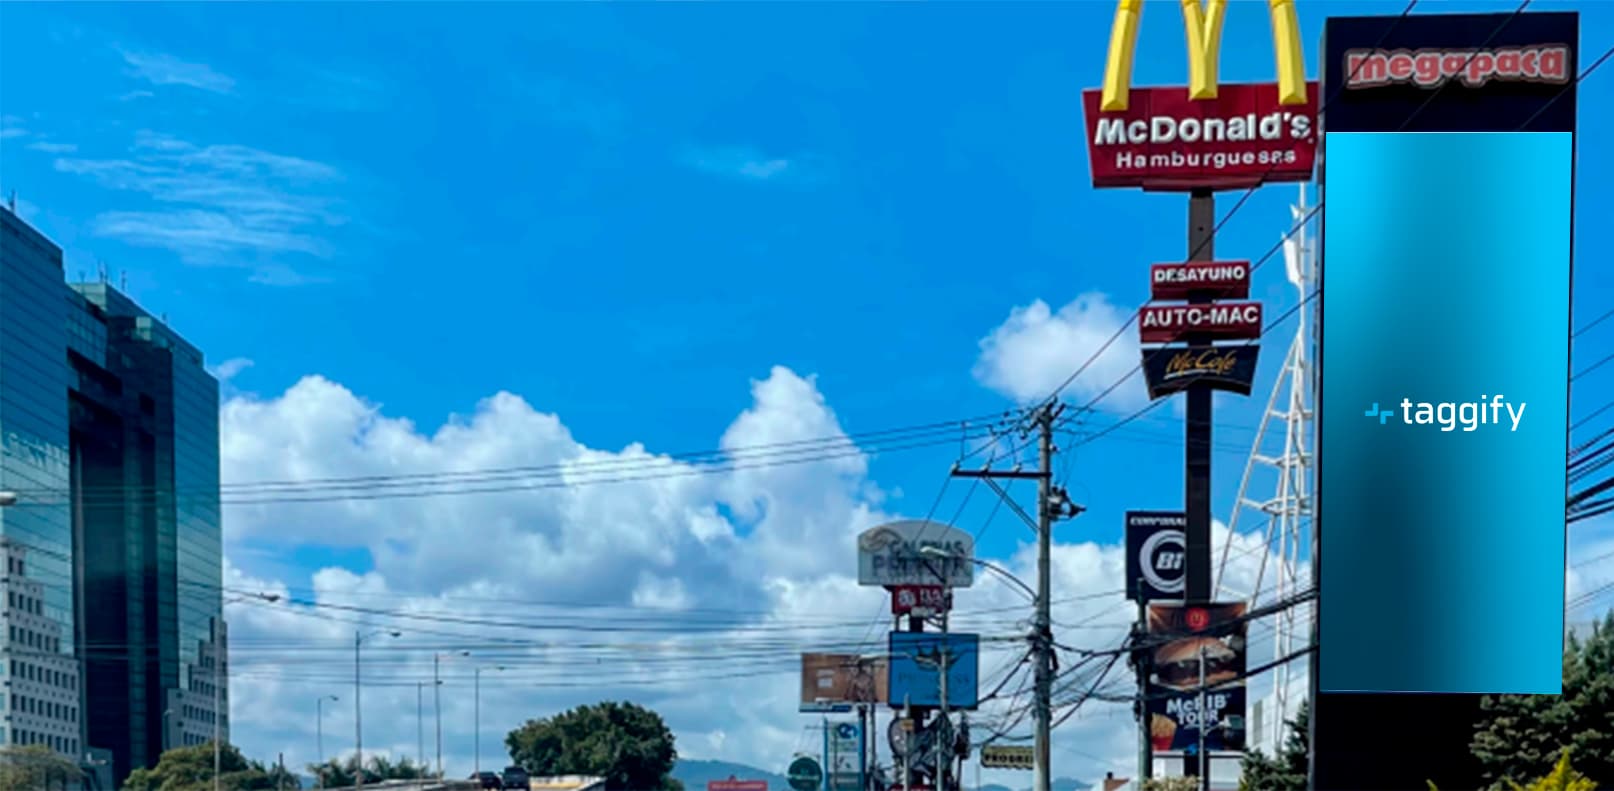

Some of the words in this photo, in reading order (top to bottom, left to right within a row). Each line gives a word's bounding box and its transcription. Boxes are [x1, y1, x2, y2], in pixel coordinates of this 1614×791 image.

[1347, 49, 1566, 84] megapaca
[1095, 113, 1310, 145] McDonald's
[1154, 265, 1245, 282] DESAYUNO
[1143, 306, 1258, 327] AUTO-MAC
[1401, 394, 1526, 432] taggify
